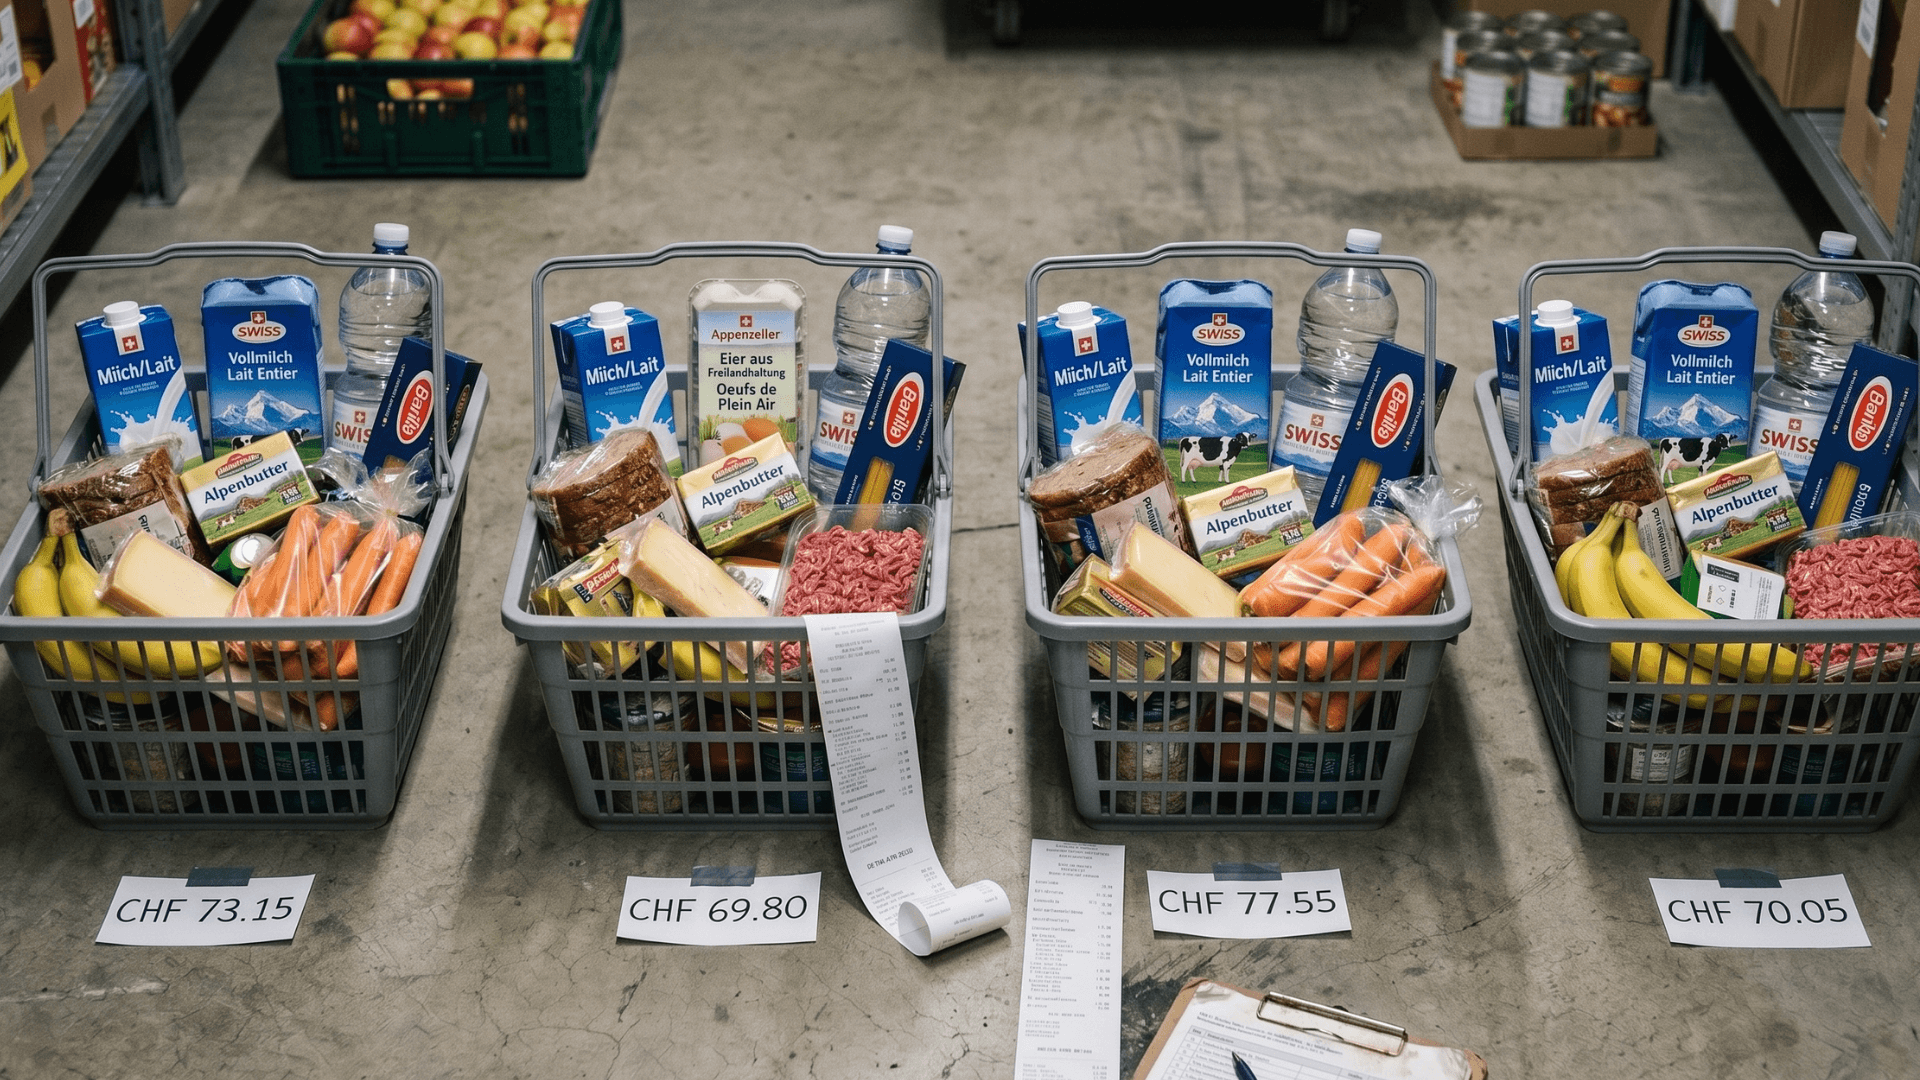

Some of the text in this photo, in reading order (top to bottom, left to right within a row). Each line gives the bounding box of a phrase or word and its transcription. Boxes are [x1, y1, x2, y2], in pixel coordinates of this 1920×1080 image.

[237, 326, 281, 338] SWISS
[711, 329, 781, 342] Appenzeller
[1196, 329, 1240, 340] SWISS
[1682, 330, 1726, 341] SWISS
[228, 351, 293, 365] Vollmilch
[720, 352, 773, 365] Eier aus
[1186, 353, 1249, 367] Vollmilch
[1671, 354, 1733, 368] Vollmilch
[227, 367, 298, 381] Lait Entier
[708, 367, 786, 380] Freilandhaltung
[1183, 370, 1253, 383] Lait Entier
[1666, 370, 1736, 385] Lait Entier
[716, 382, 777, 396] Oeufs de
[719, 398, 776, 411] Plein Air
[334, 421, 372, 444] SWIS
[819, 421, 859, 446] SWIS
[204, 462, 289, 504] Alpenbutter
[701, 463, 784, 509] Alpenbutter
[1691, 484, 1778, 524] Alpenbutter
[1206, 499, 1293, 535] Alpenbutter
[629, 895, 807, 922] CHF 69.80
[1158, 889, 1336, 914] CHF 77.55
[116, 896, 294, 923] CHF 73.15
[1668, 898, 1848, 924] CHF 70.05
